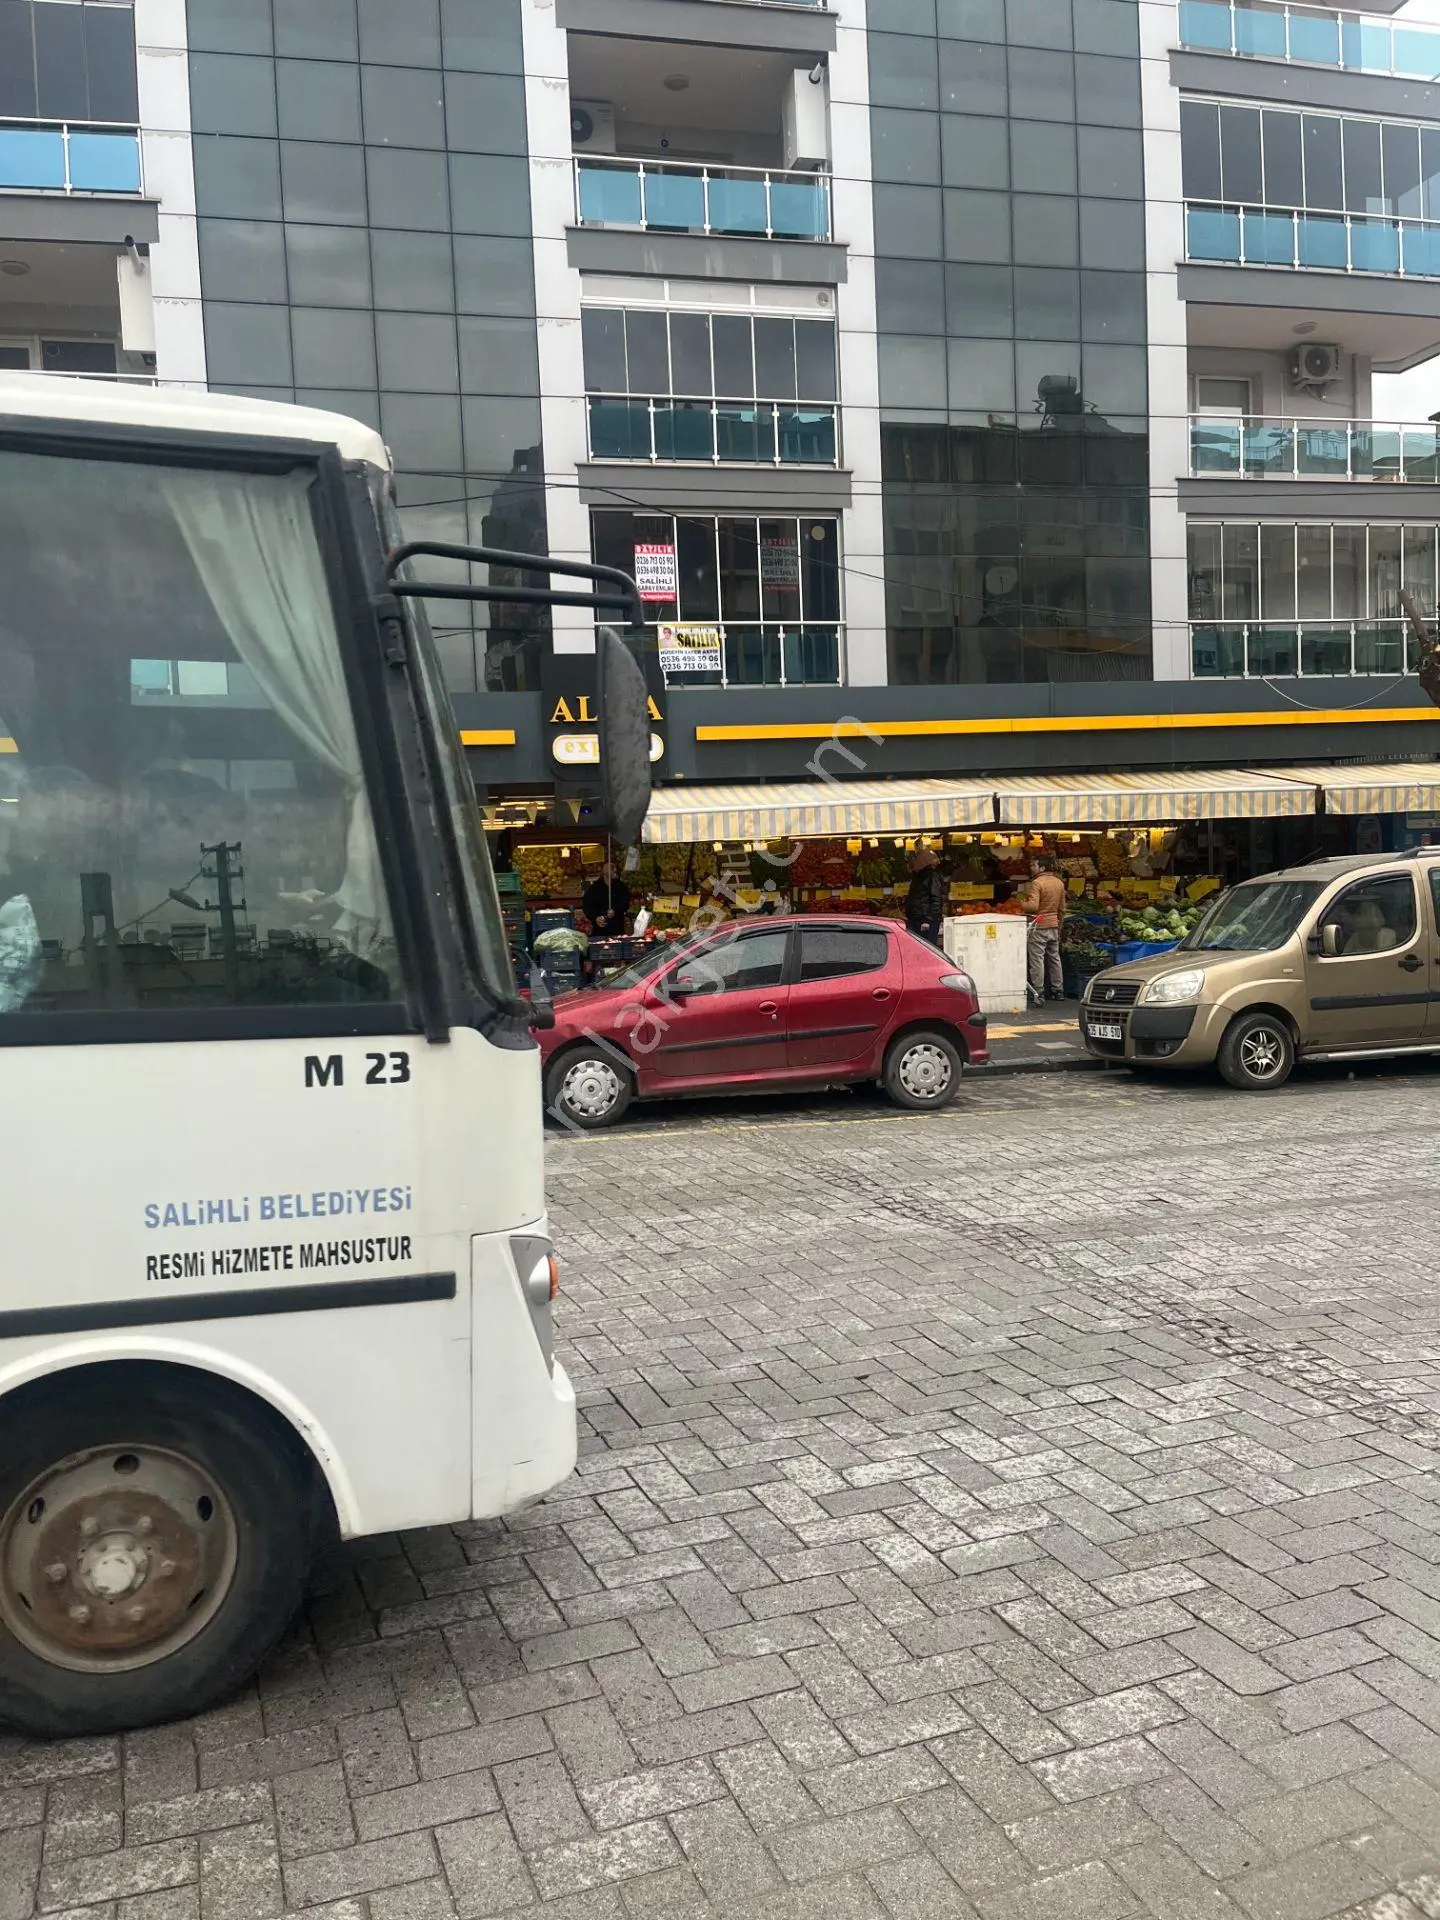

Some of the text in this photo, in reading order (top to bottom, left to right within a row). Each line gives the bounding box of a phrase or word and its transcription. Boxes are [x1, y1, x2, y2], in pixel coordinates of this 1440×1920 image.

[676, 633, 719, 648] SATILIK
[304, 1051, 411, 1088] M 23
[299, 1235, 413, 1269] MAHSUSTUR
